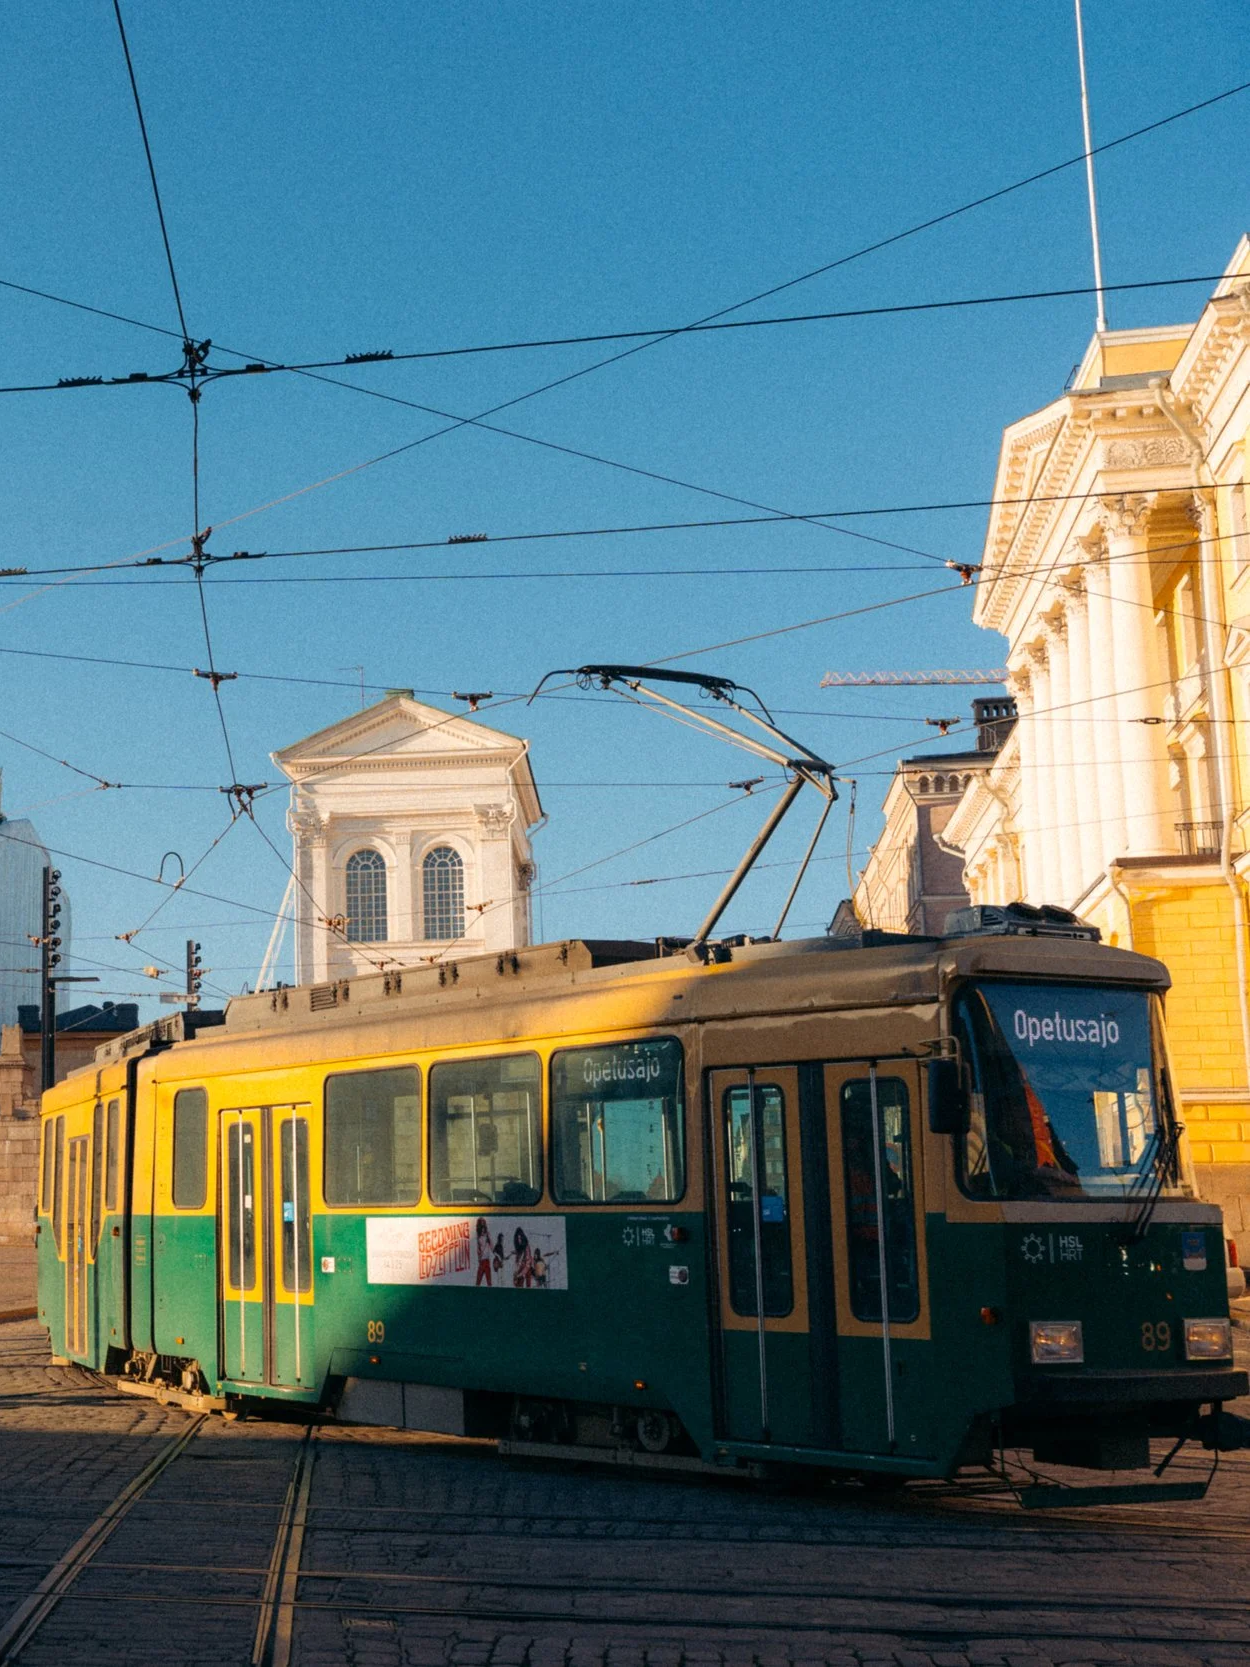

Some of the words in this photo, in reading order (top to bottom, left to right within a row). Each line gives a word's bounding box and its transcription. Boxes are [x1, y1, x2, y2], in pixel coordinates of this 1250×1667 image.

[1014, 1009, 1120, 1049] Opetusajo
[583, 1055, 661, 1088] Opetusajo
[418, 1221, 470, 1253] BECOMING
[1059, 1235, 1084, 1248] HSL
[1060, 1248, 1084, 1261] HRT
[367, 1320, 385, 1343] 89
[1141, 1321, 1171, 1351] 89
